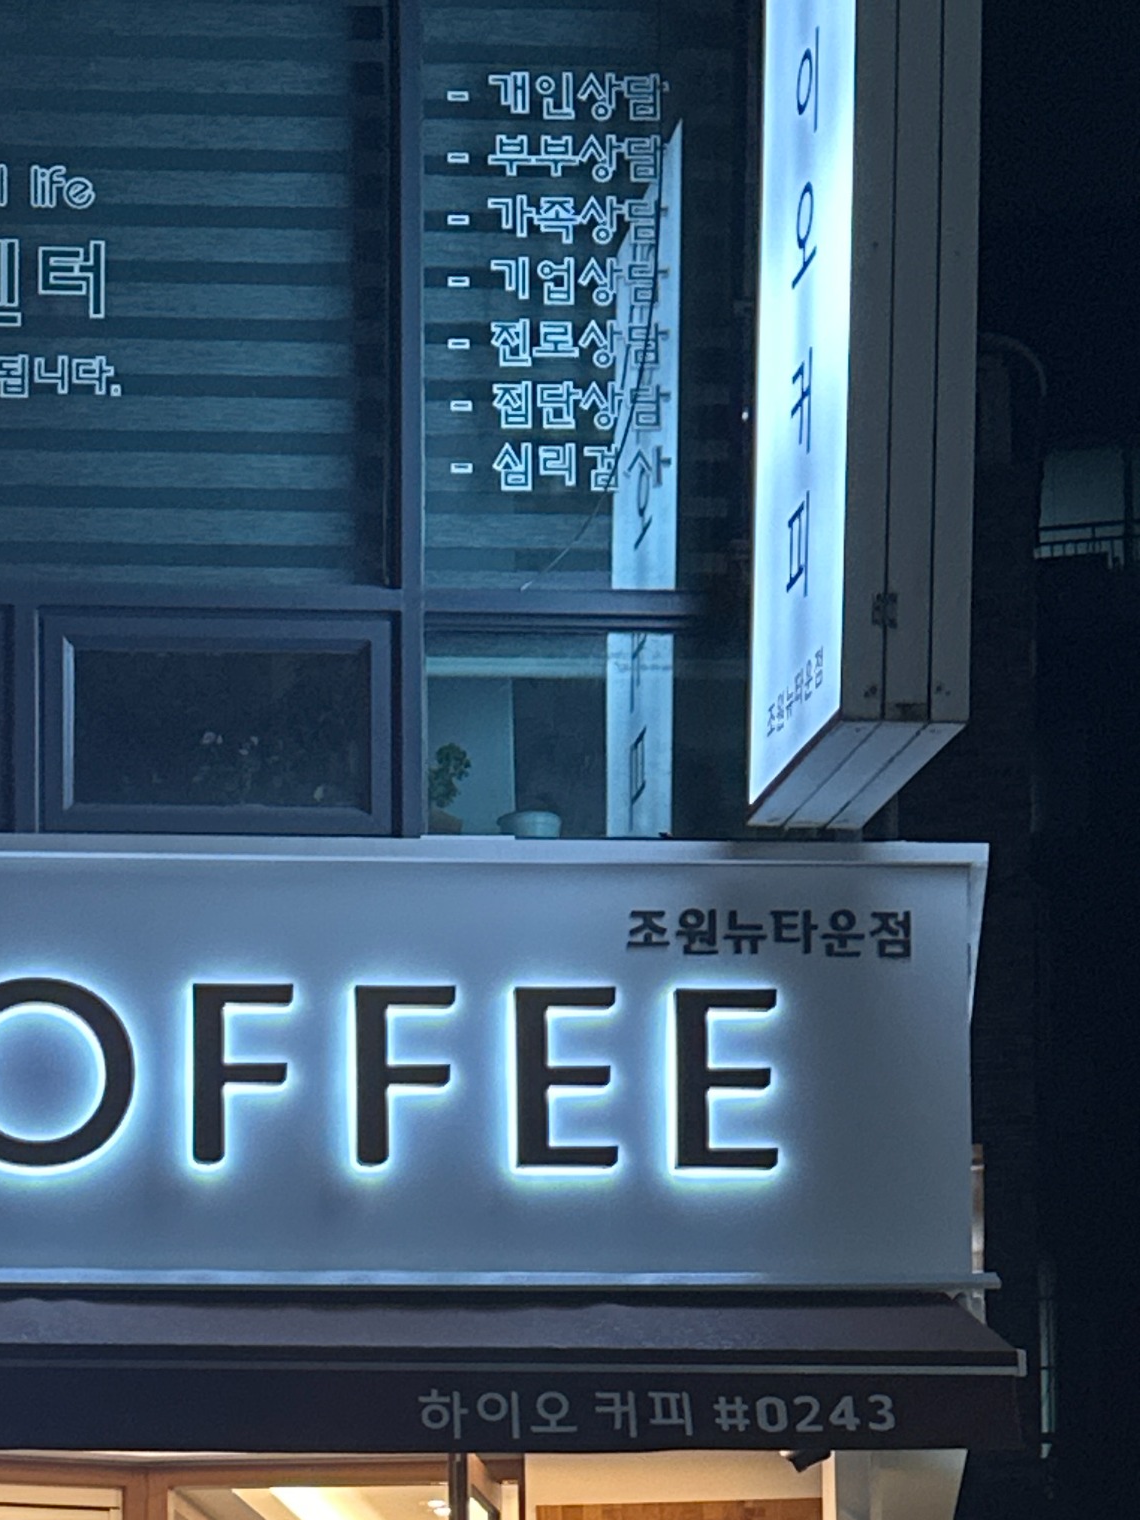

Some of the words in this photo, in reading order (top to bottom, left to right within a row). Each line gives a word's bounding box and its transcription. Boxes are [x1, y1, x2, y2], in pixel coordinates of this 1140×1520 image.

[488, 70, 670, 121] 개인상담
[488, 134, 668, 183] 부부상담
[30, 164, 95, 209] life
[488, 194, 669, 245] 가족상담
[491, 256, 669, 306] 기업상담
[491, 318, 670, 368] 진로상담
[492, 380, 671, 430] 집단상담
[626, 907, 913, 959] 조원뉴타운점
[418, 1387, 578, 1439] 하이오
[594, 1389, 694, 1437] 커피
[713, 1394, 897, 1433] #0243
